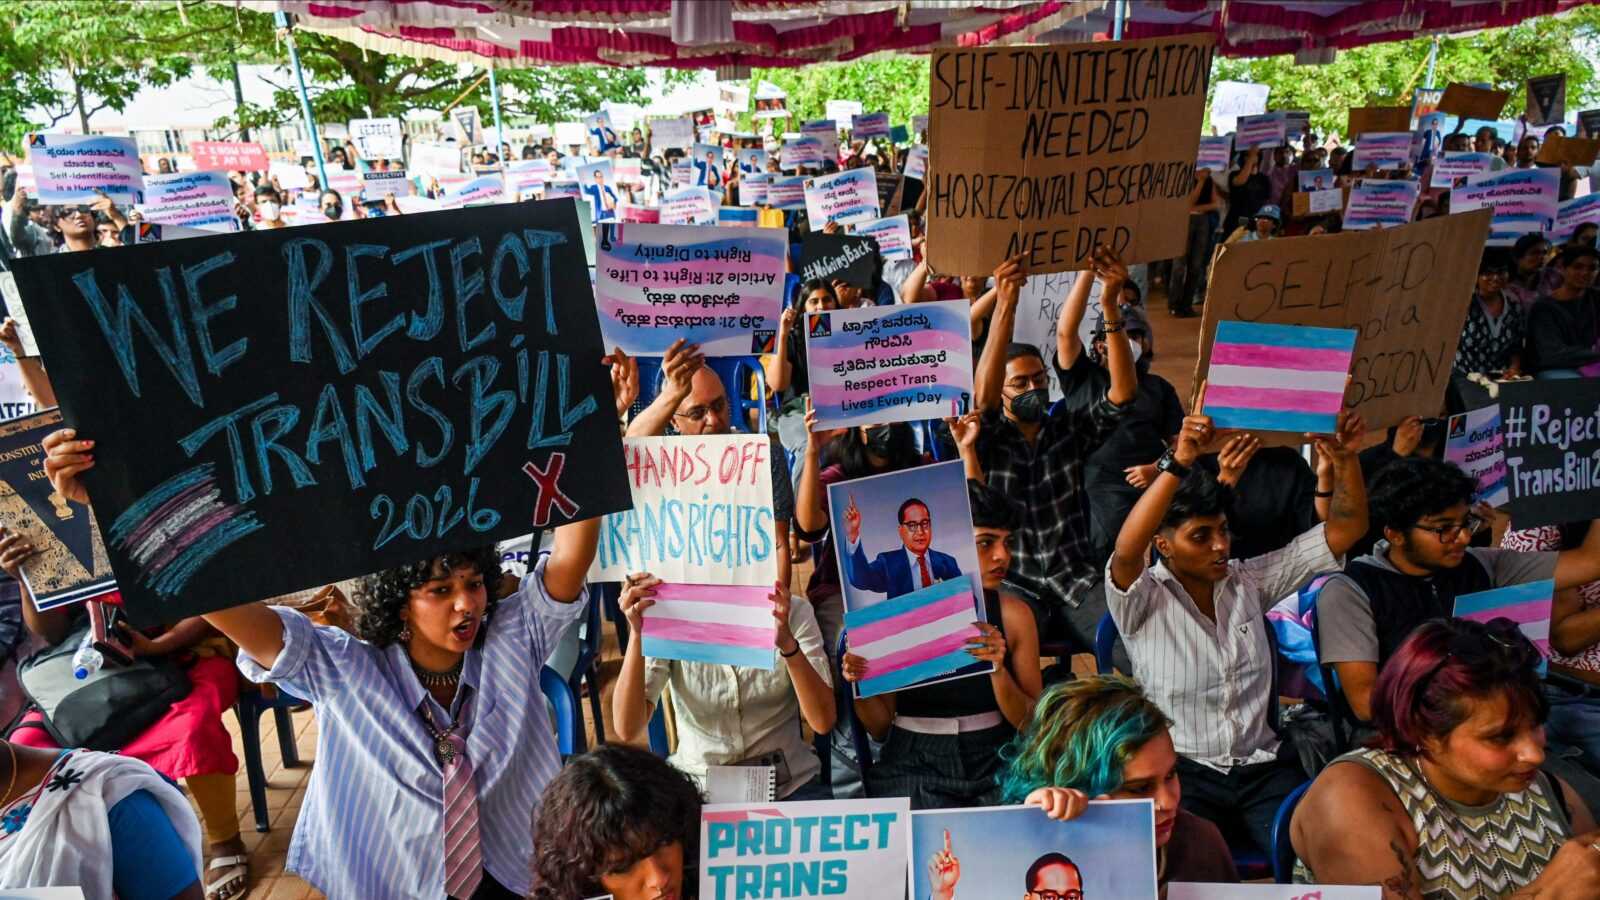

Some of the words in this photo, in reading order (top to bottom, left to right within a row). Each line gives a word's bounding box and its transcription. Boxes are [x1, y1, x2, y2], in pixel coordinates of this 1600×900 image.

[935, 43, 1216, 110] SELF-IDENTIFICATION
[1021, 108, 1149, 159] NEEDED
[935, 171, 1080, 220] HORIZONTAL
[634, 243, 690, 261] Dignity
[694, 249, 710, 261] to
[714, 247, 751, 262] Right
[1005, 226, 1130, 268] NEEDED
[606, 269, 639, 283] Life,
[643, 269, 659, 282] to
[662, 270, 702, 284] Right
[705, 272, 725, 285] 21:
[728, 272, 776, 285] Article
[72, 249, 252, 407] WE
[282, 229, 569, 375] REJECT
[864, 335, 913, 350] ಗೌರವಿಸಿ
[833, 358, 877, 377] ಪ್ರತಿದಿನ
[844, 376, 898, 392] Respect
[900, 373, 937, 385] Trans
[841, 398, 874, 412] Lives
[877, 395, 913, 410] Every
[916, 392, 942, 405] Day
[27, 469, 48, 480] IND
[624, 442, 711, 489] HANDS
[719, 441, 768, 485] OFF
[371, 478, 501, 551] 2026
[707, 812, 898, 859] PROTECT
[707, 859, 848, 900] TRANS
